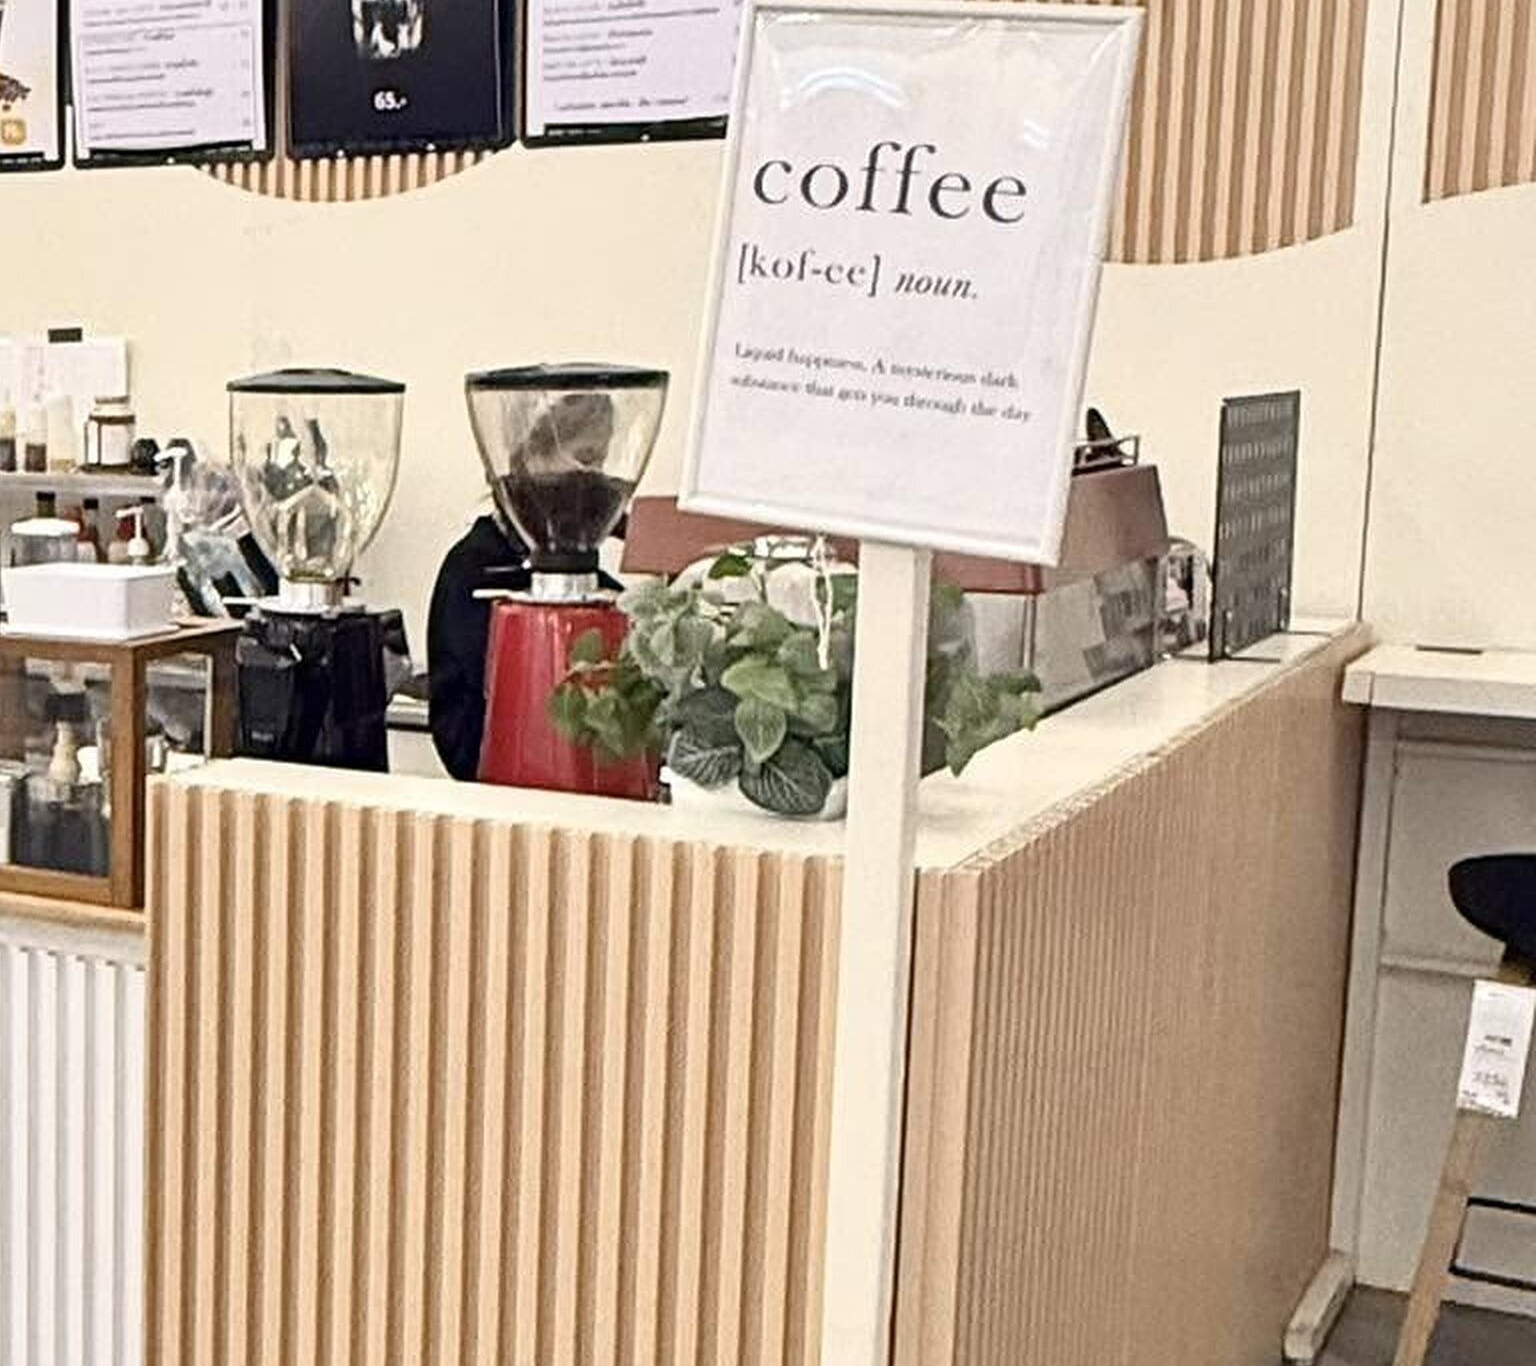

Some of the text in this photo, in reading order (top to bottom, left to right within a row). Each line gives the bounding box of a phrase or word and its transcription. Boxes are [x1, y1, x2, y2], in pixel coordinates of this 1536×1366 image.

[752, 140, 1029, 225] coffee
[736, 241, 980, 301] [kof-ee] noun.
[871, 357, 887, 375] A
[980, 370, 1019, 388] dark
[805, 379, 834, 397] that
[870, 390, 899, 407] you
[970, 399, 997, 416] the
[1001, 403, 1032, 423] day
